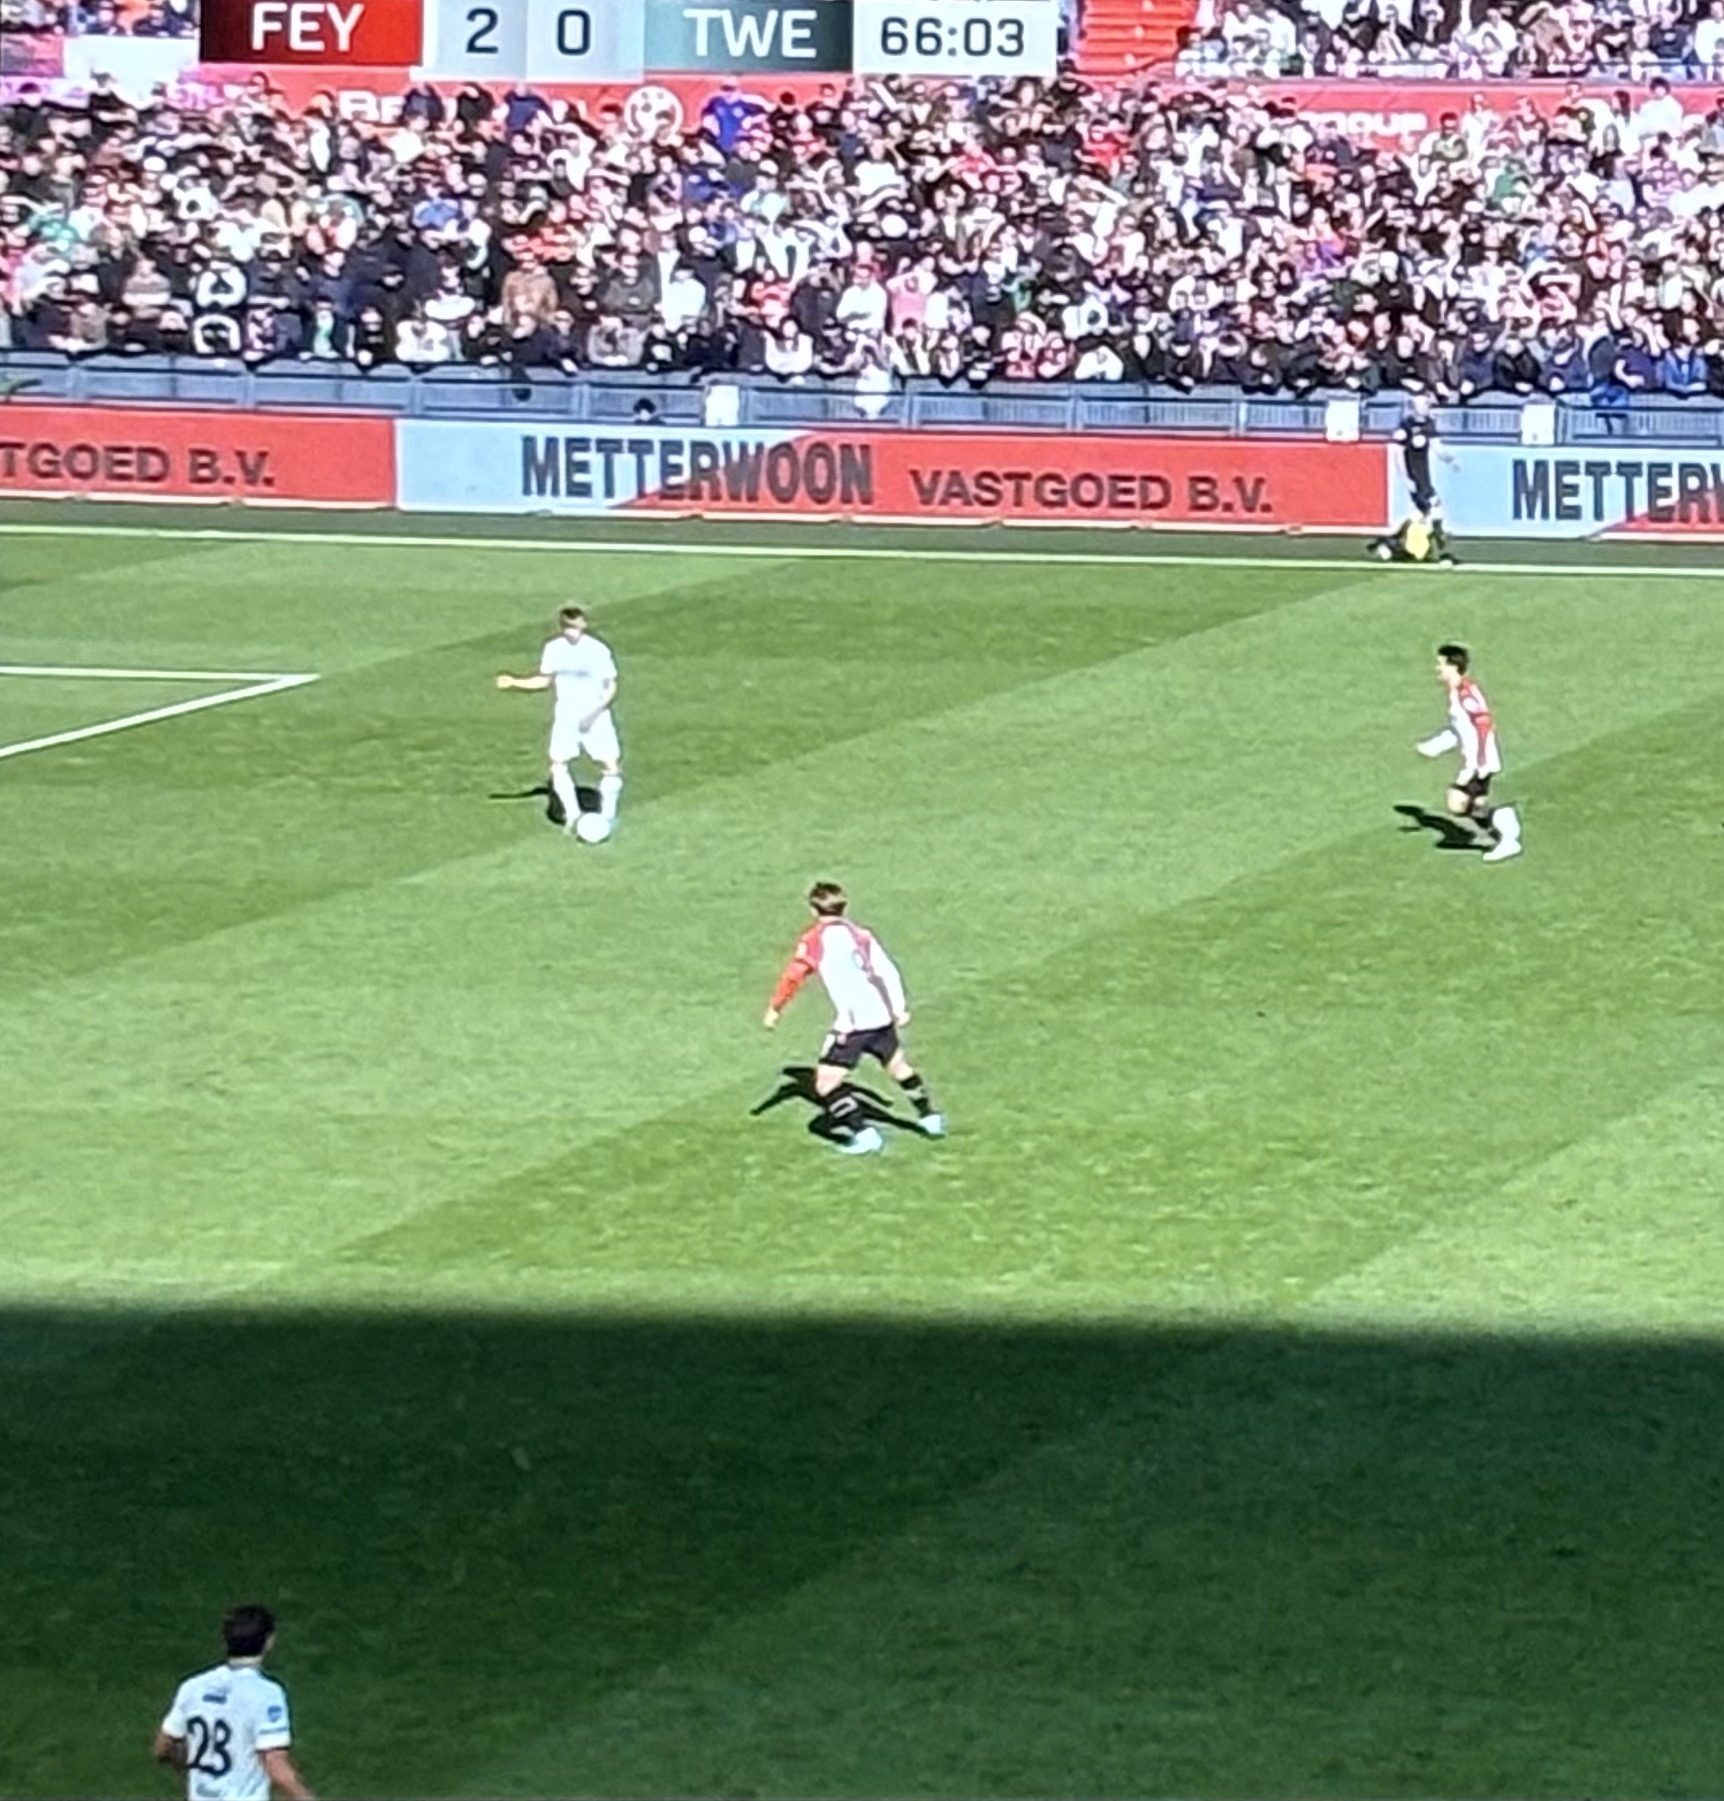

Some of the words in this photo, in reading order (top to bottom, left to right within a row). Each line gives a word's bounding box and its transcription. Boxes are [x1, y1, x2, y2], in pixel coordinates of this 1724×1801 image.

[188, 448, 275, 487] B.V.
[521, 435, 874, 505] METTERWOON
[909, 469, 1173, 511] VASTGOED
[1187, 475, 1273, 514] B.V.
